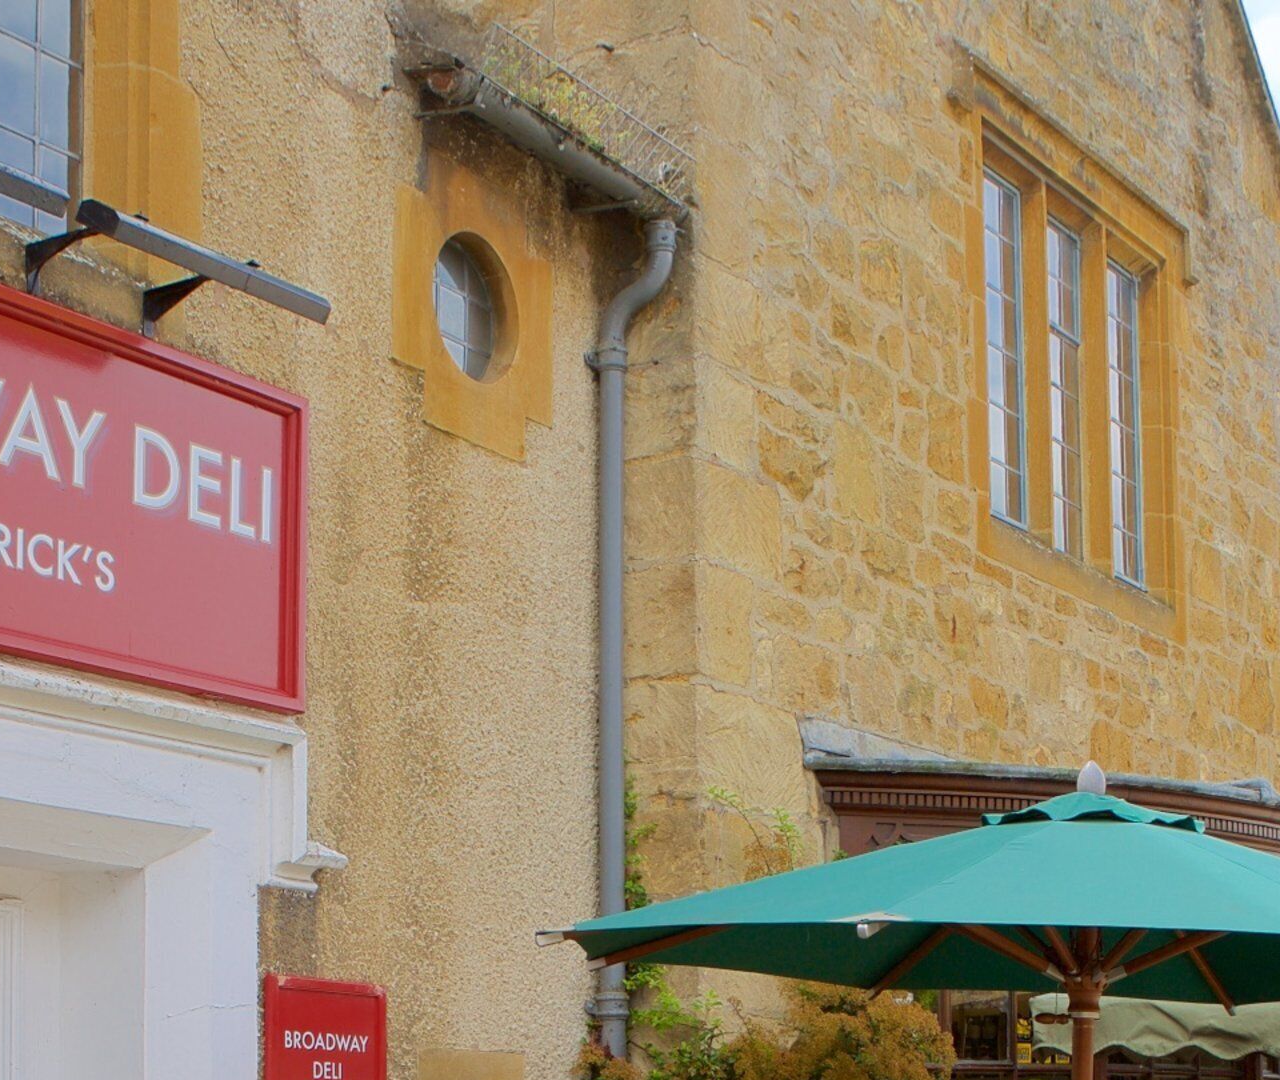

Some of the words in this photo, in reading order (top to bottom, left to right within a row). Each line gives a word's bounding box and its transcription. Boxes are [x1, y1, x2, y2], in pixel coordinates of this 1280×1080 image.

[133, 423, 273, 544] DELI
[284, 1030, 368, 1052] BROADWAY
[312, 1061, 342, 1080] DELI
